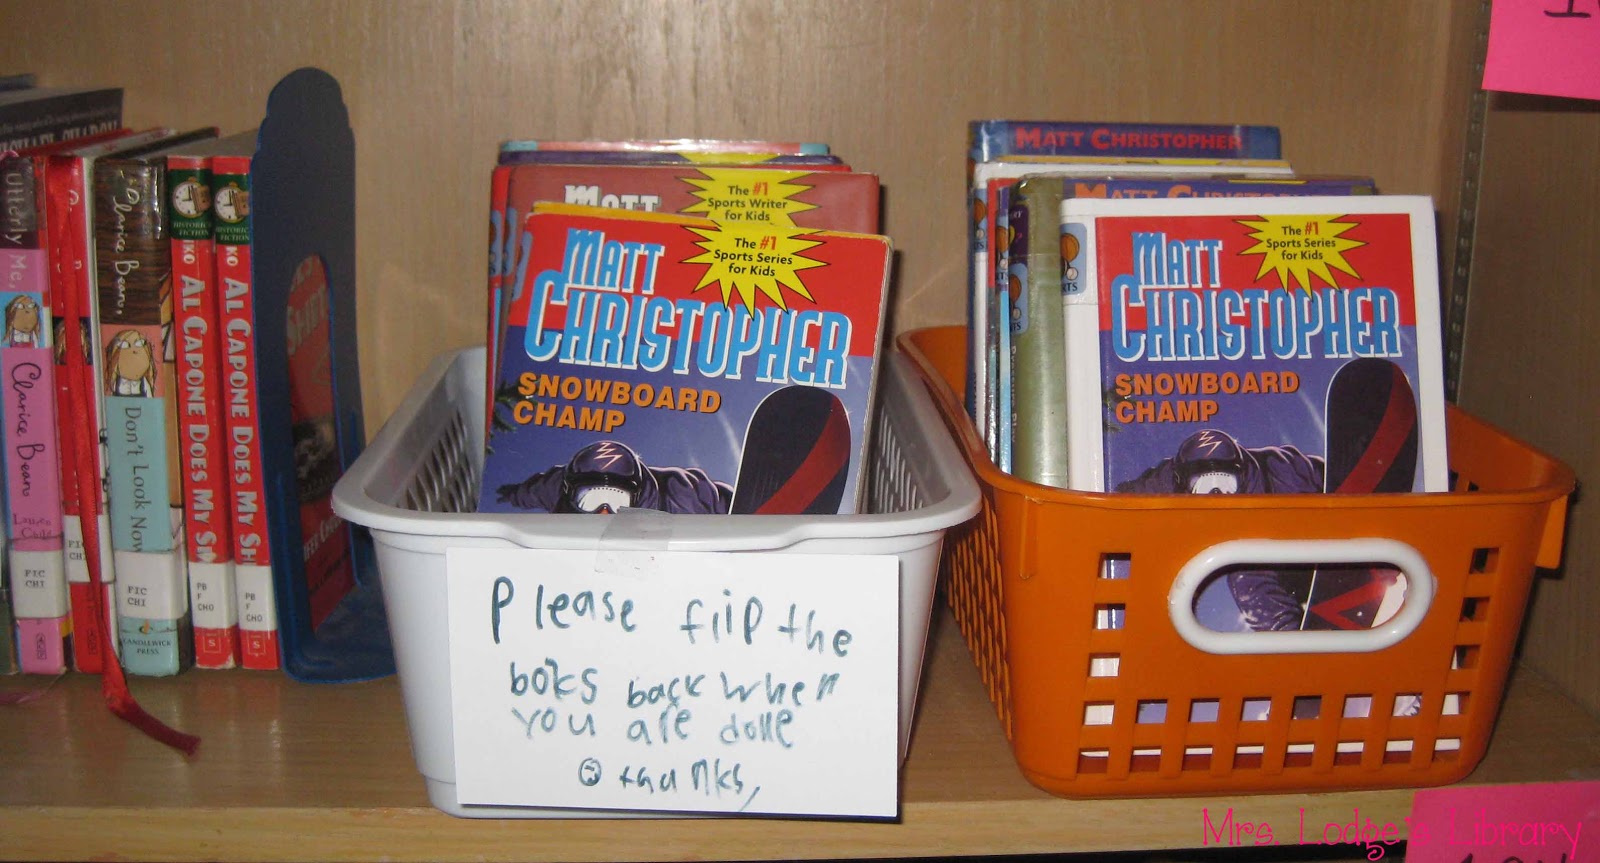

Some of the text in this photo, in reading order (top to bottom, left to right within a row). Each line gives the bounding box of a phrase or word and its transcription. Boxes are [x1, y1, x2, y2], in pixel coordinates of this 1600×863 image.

[1015, 126, 1243, 151] MATT CHRISTOPHER
[728, 181, 769, 196] The #1
[707, 197, 787, 212] Sports Writer
[724, 210, 771, 222] for Kids
[734, 235, 777, 249] The #1
[1281, 221, 1320, 236] The #1
[713, 250, 793, 265] Sports Series
[1266, 237, 1336, 251] Sports Series
[1281, 250, 1324, 261] for Kids
[563, 227, 665, 295] MATT
[728, 263, 776, 277] for Kids
[1131, 231, 1223, 288] MATT
[114, 259, 140, 316] Bean,
[181, 274, 206, 312] AL
[224, 277, 249, 314] AL
[524, 269, 853, 390] CHRISTOPHER
[1110, 273, 1403, 363] CHRISTOPHER
[5, 172, 46, 497] Utterly Me, Clarice Bean
[183, 315, 208, 416] CAPONE
[226, 318, 251, 419] CAPONE
[517, 371, 723, 414] SNOWBOARD
[1114, 371, 1300, 397] SNOWBOARD
[513, 399, 626, 433] CHAMP
[1115, 400, 1220, 424] CHAMP
[124, 406, 144, 457] Don't
[189, 424, 210, 482] DOES
[232, 426, 254, 485] DOES
[132, 464, 151, 511] Look
[192, 489, 214, 524] MY
[237, 491, 258, 526] MY
[24, 569, 46, 578] FIC
[25, 580, 45, 588] CHI
[196, 583, 207, 591] PB
[127, 586, 148, 596] FIC
[127, 597, 146, 607] CHI
[197, 593, 202, 601] F
[245, 592, 256, 601] PB
[197, 604, 214, 612] CHO
[491, 575, 637, 644] Please
[777, 602, 853, 657] the
[136, 647, 160, 656] PRESS
[627, 673, 706, 709] back
[719, 670, 841, 706] when
[511, 706, 596, 740] you
[626, 702, 692, 745] are
